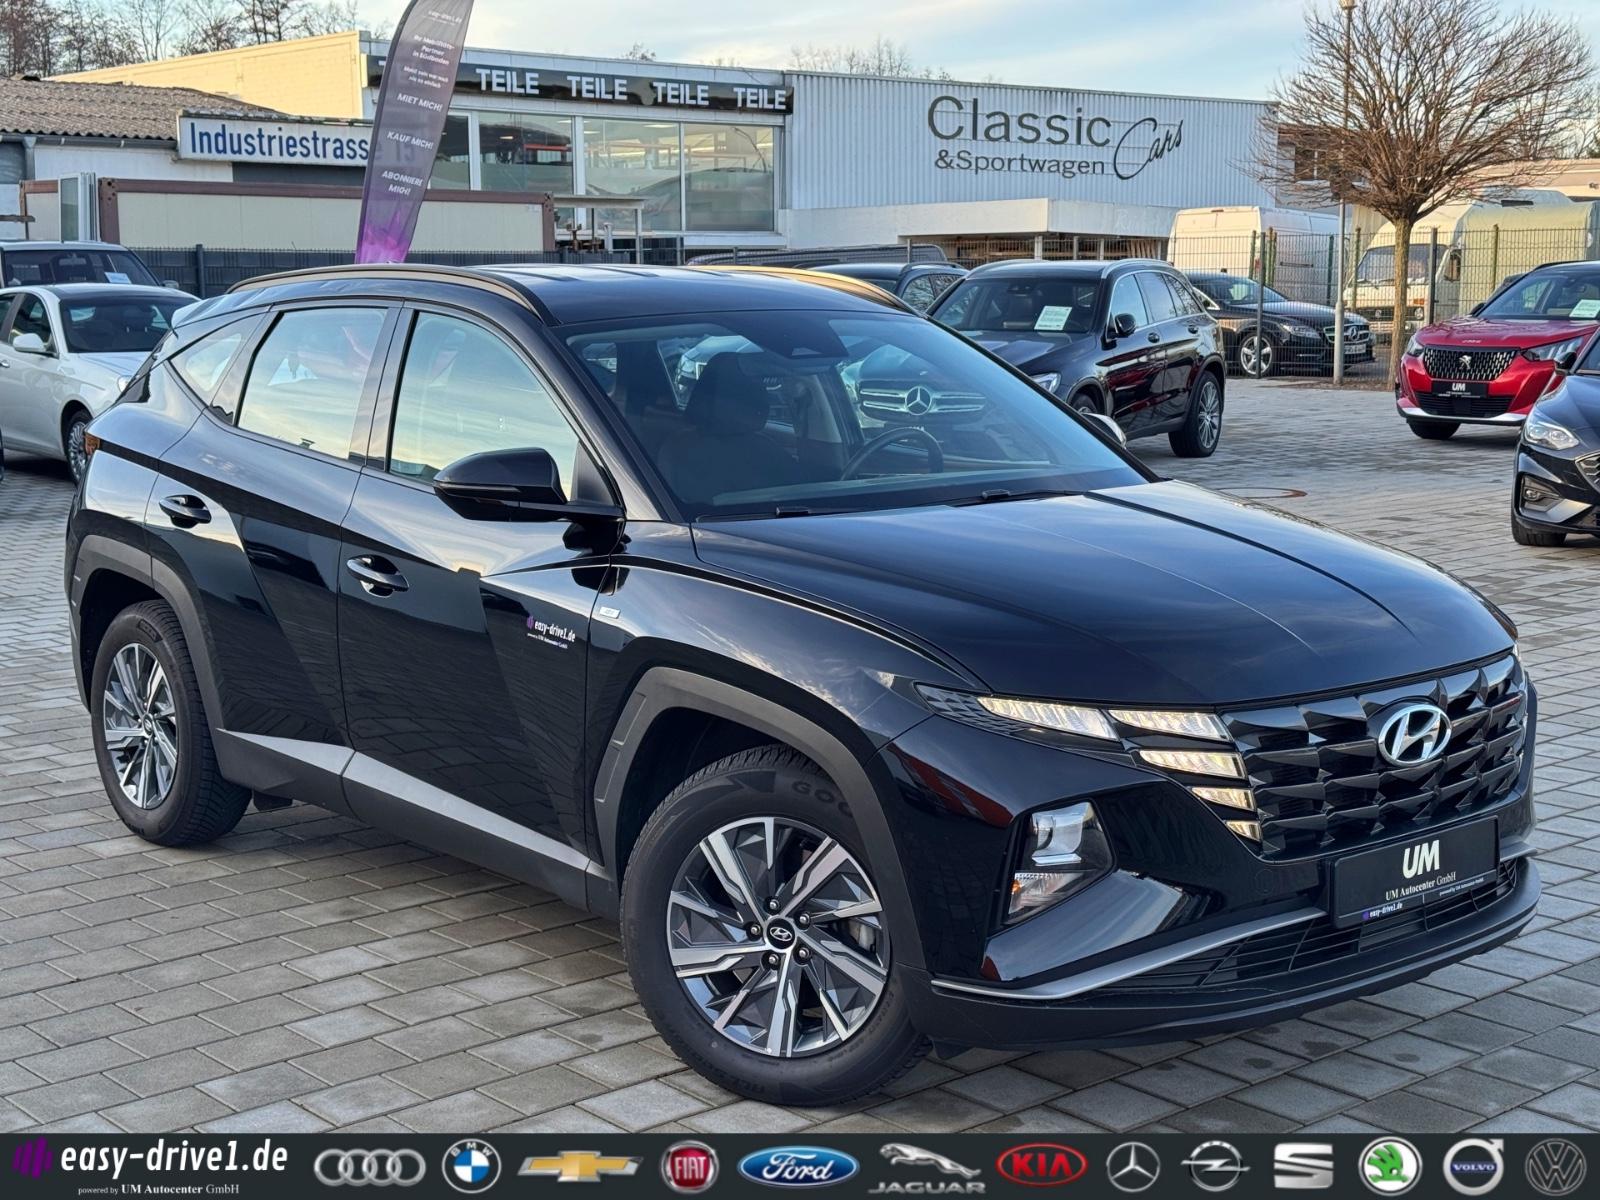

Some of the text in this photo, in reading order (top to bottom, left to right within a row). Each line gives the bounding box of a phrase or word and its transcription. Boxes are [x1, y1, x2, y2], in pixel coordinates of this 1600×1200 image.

[475, 67, 787, 111] TEILE TEILE TEILE TEILE
[396, 93, 444, 112] MIET MICH!
[190, 122, 370, 161] Industriestrass
[387, 131, 434, 150] KAUF MICH!
[927, 95, 1184, 180] Classic Cars
[934, 149, 1106, 179] &Sportwagen
[388, 184, 412, 196] MICH!
[1452, 383, 1466, 391] UM
[534, 620, 576, 643] easy-drive1.de
[1402, 839, 1440, 879] UM
[1385, 888, 1399, 901] UM
[1399, 879, 1436, 898] Autocenter
[1436, 871, 1457, 886] GmbH
[1369, 902, 1403, 918] easy-drive1.de
